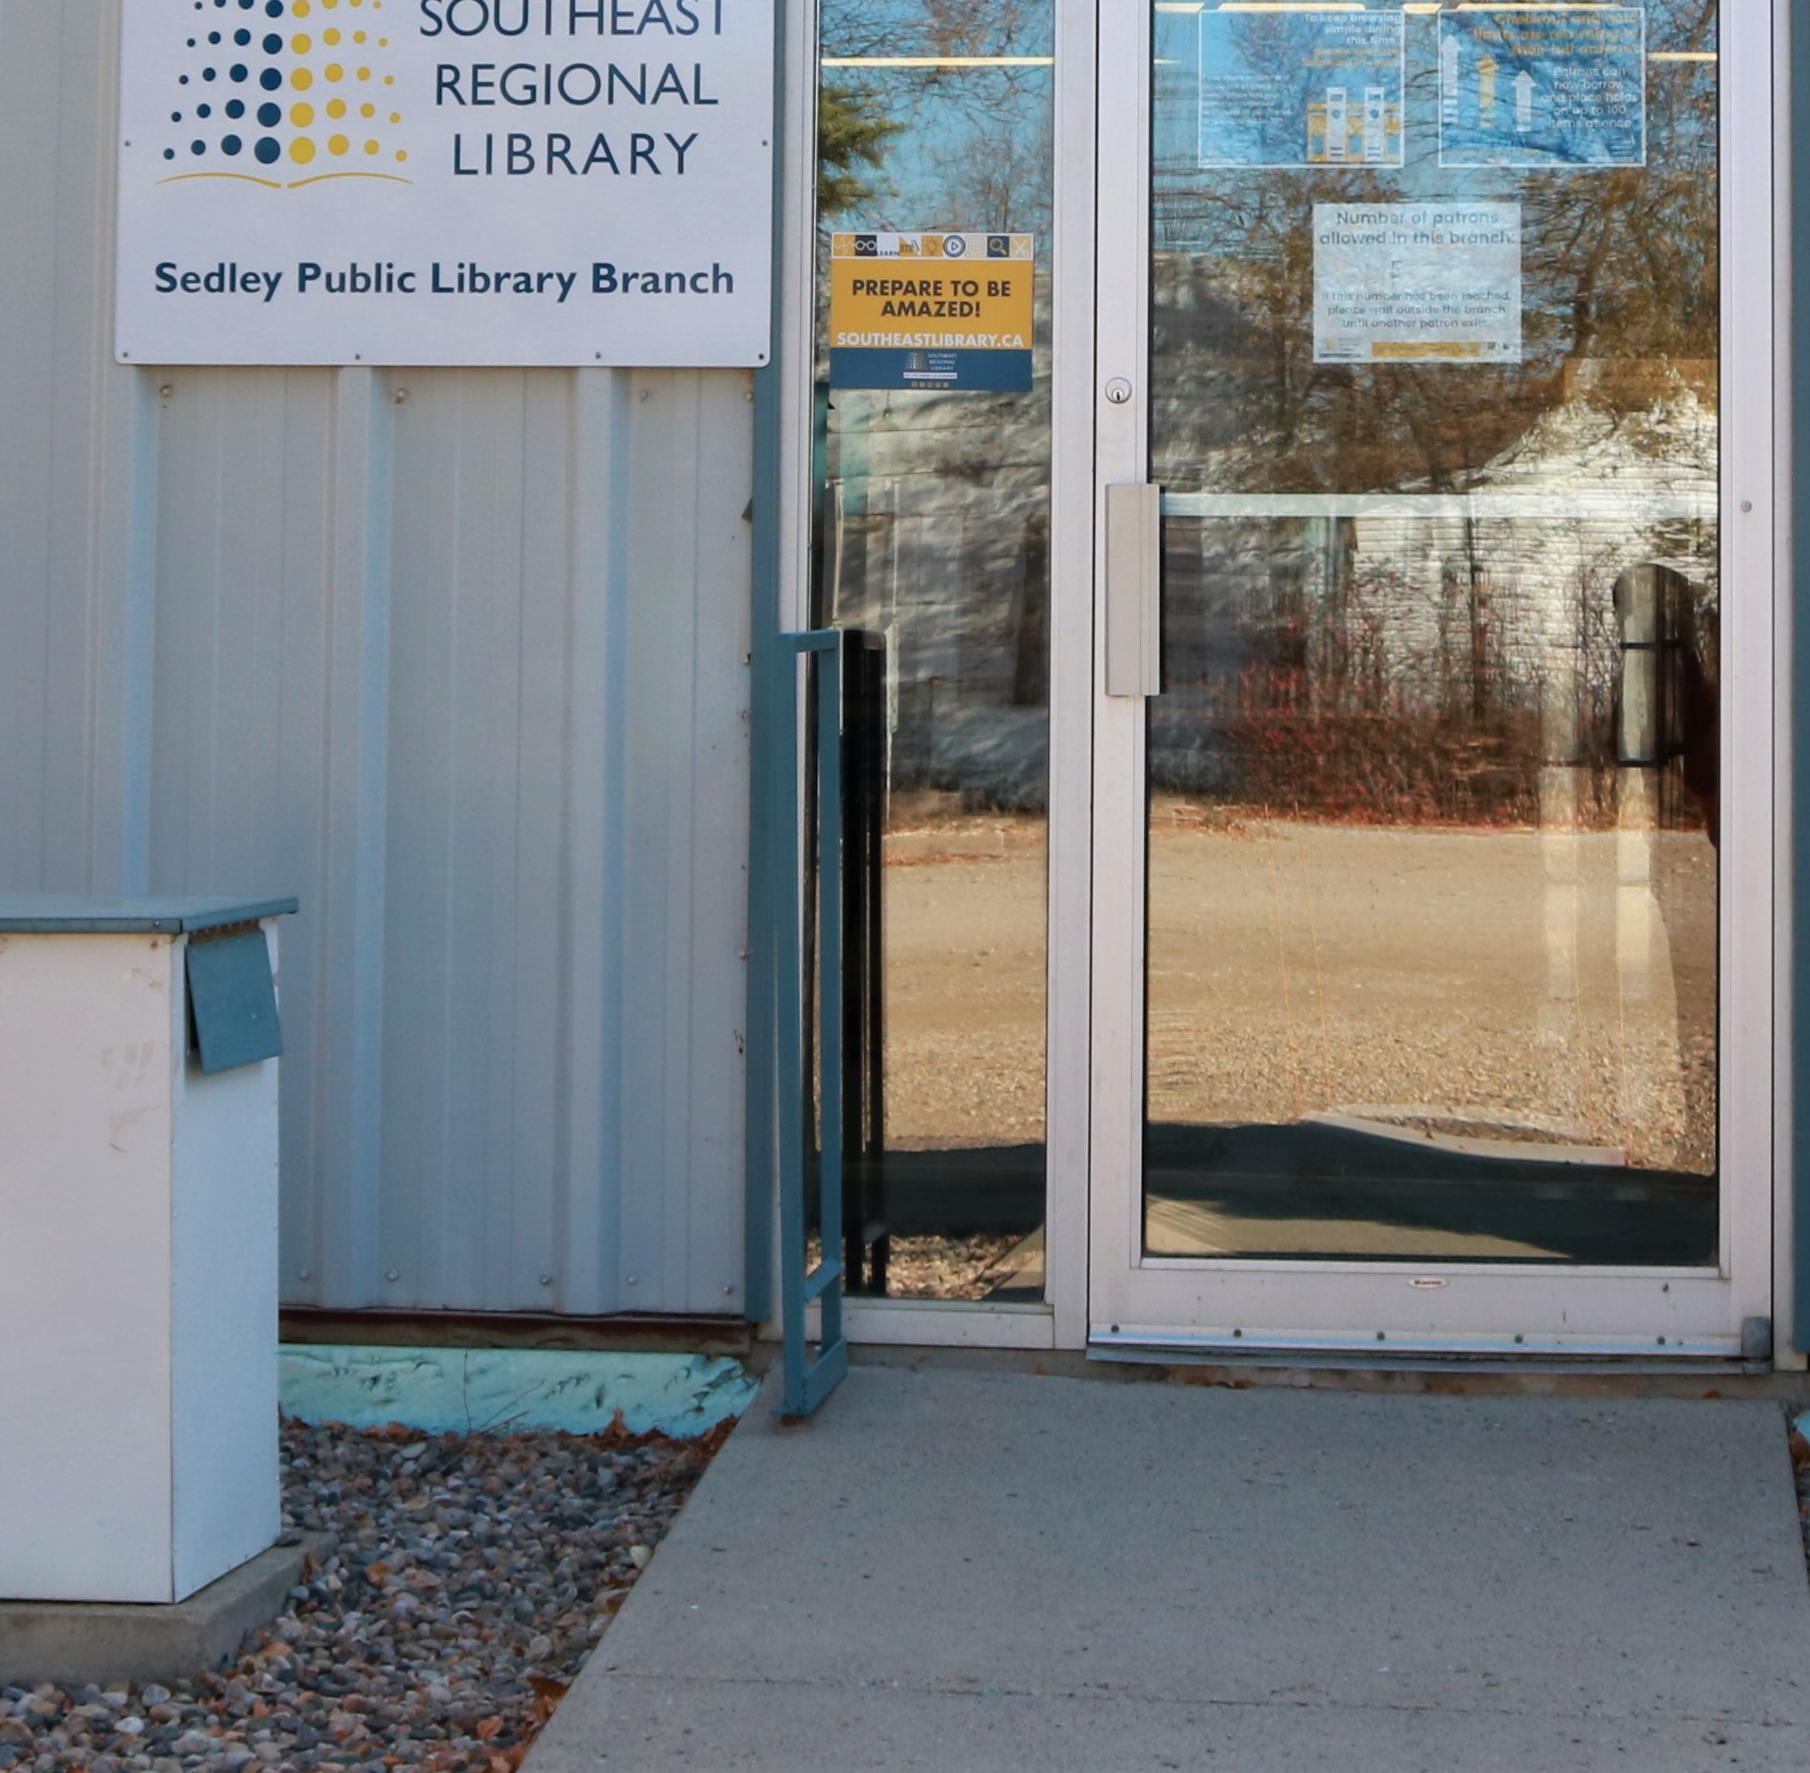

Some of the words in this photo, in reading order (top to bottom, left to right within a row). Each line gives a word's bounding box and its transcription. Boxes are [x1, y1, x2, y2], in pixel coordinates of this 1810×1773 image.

[1305, 13, 1317, 22] To
[1321, 13, 1347, 25] keep
[1350, 13, 1401, 25] browsing
[1324, 24, 1361, 36] simple
[1364, 24, 1402, 36] during
[1346, 35, 1366, 45] this
[436, 63, 718, 106] REGIONAL
[1605, 92, 1638, 103] holds
[454, 133, 698, 176] LIBRARY
[1337, 211, 1404, 225] Number
[1411, 211, 1427, 224] of
[1433, 212, 1499, 228] patrons
[1320, 230, 1386, 245] allowed
[1392, 230, 1407, 244] in
[1414, 230, 1443, 244] this
[1450, 230, 1516, 245] branch:
[154, 262, 283, 303] Sedley
[297, 261, 416, 295] Public
[430, 261, 577, 303] Library
[591, 261, 735, 295] Branch
[852, 279, 943, 297] PREPARE
[951, 280, 979, 297] TO
[987, 281, 1011, 297] BE
[1357, 292, 1402, 301] number
[1430, 292, 1458, 301] been
[881, 300, 981, 318] AMAZED!
[1328, 306, 1366, 316] please
[1369, 306, 1393, 315] wait
[1397, 306, 1439, 314] outside
[1442, 306, 1461, 314] the
[1464, 306, 1506, 315] branch
[1343, 319, 1368, 327] until
[1371, 319, 1417, 327] another
[1420, 319, 1458, 329] patron
[837, 332, 1024, 348] SOUTHEASTLIBRARY.CA
